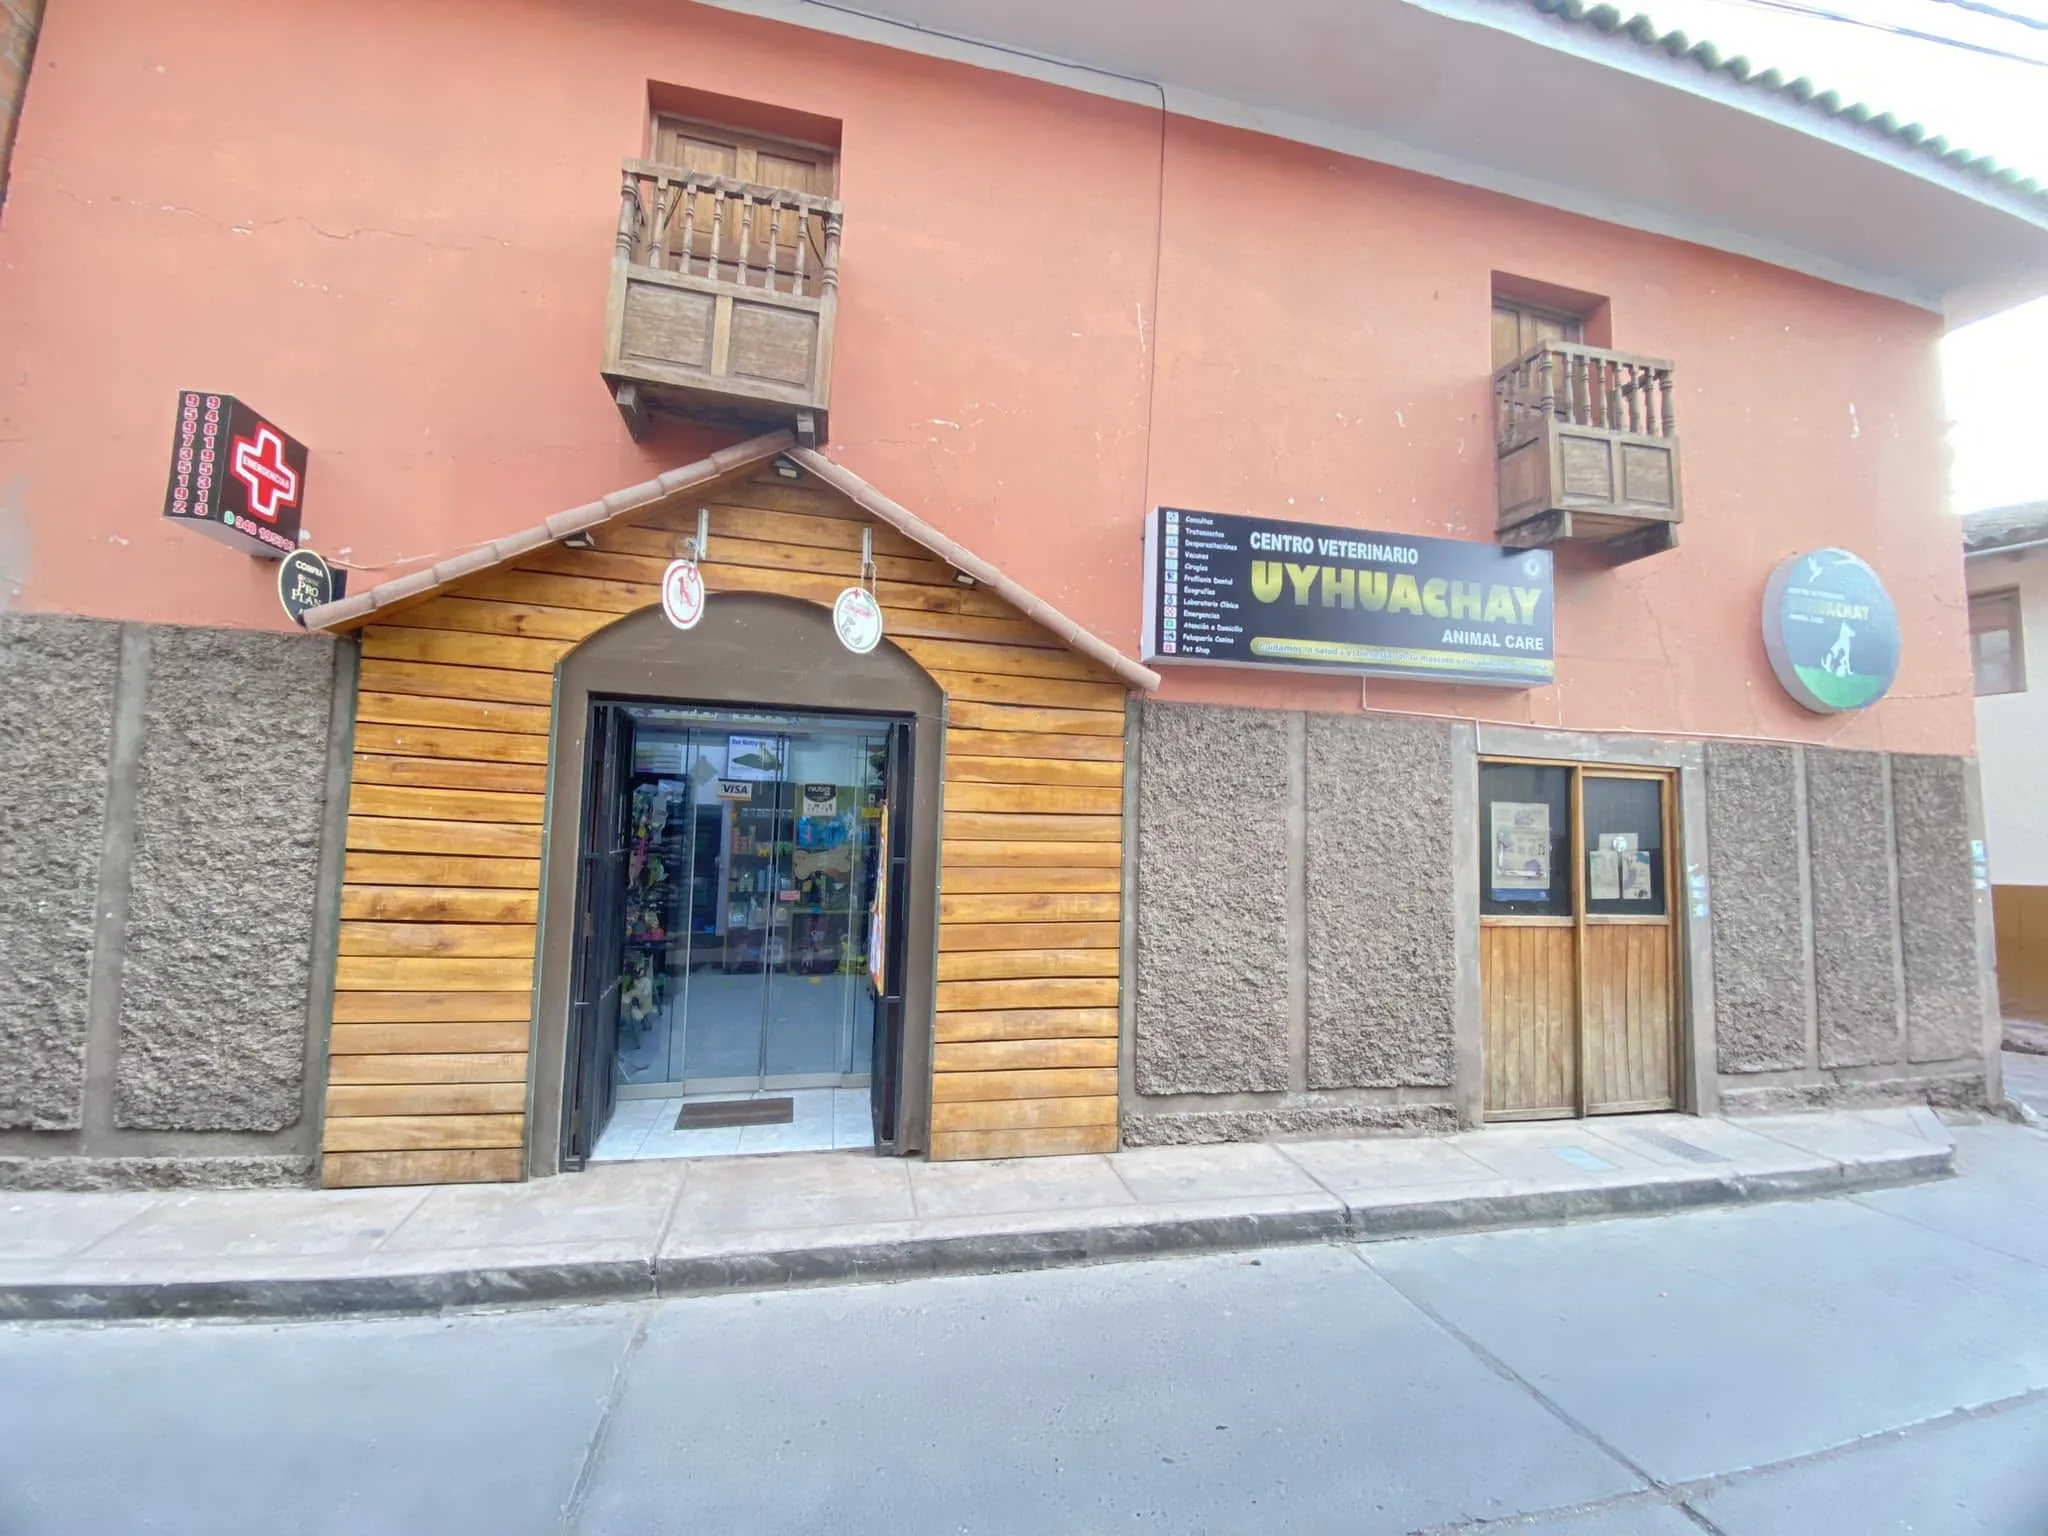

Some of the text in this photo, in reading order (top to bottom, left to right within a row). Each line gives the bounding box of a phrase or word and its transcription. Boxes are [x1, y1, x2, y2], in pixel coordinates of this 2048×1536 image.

[235, 515, 257, 536] 948
[1250, 531, 1419, 565] CENTRO VETERINARIO
[298, 582, 319, 597] PRO
[1250, 559, 1542, 625] UYHUACHAY
[1195, 646, 1211, 655] Shop
[1442, 629, 1545, 651] ANIMAL CARE
[723, 784, 748, 793] VISA
